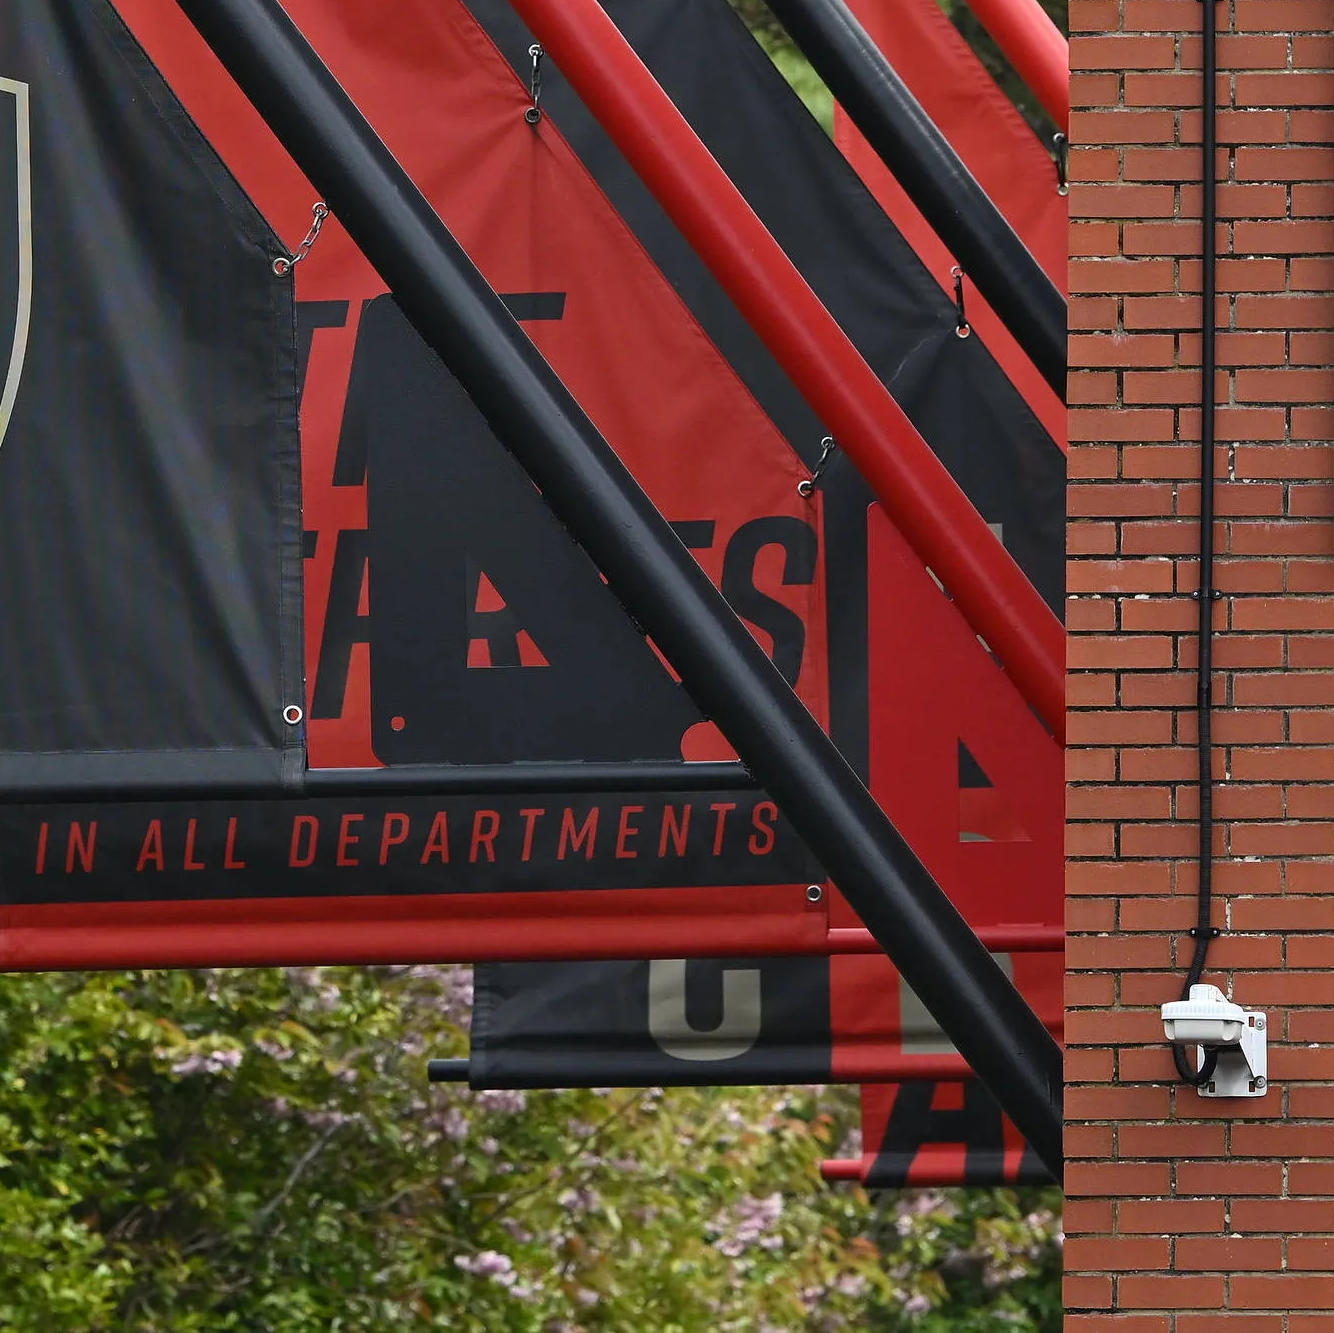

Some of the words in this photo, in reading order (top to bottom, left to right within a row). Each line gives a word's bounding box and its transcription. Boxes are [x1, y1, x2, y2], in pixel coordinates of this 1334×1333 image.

[35, 820, 98, 875] IN
[136, 816, 247, 872] ALL
[288, 800, 779, 869] DEPARTMENTS
